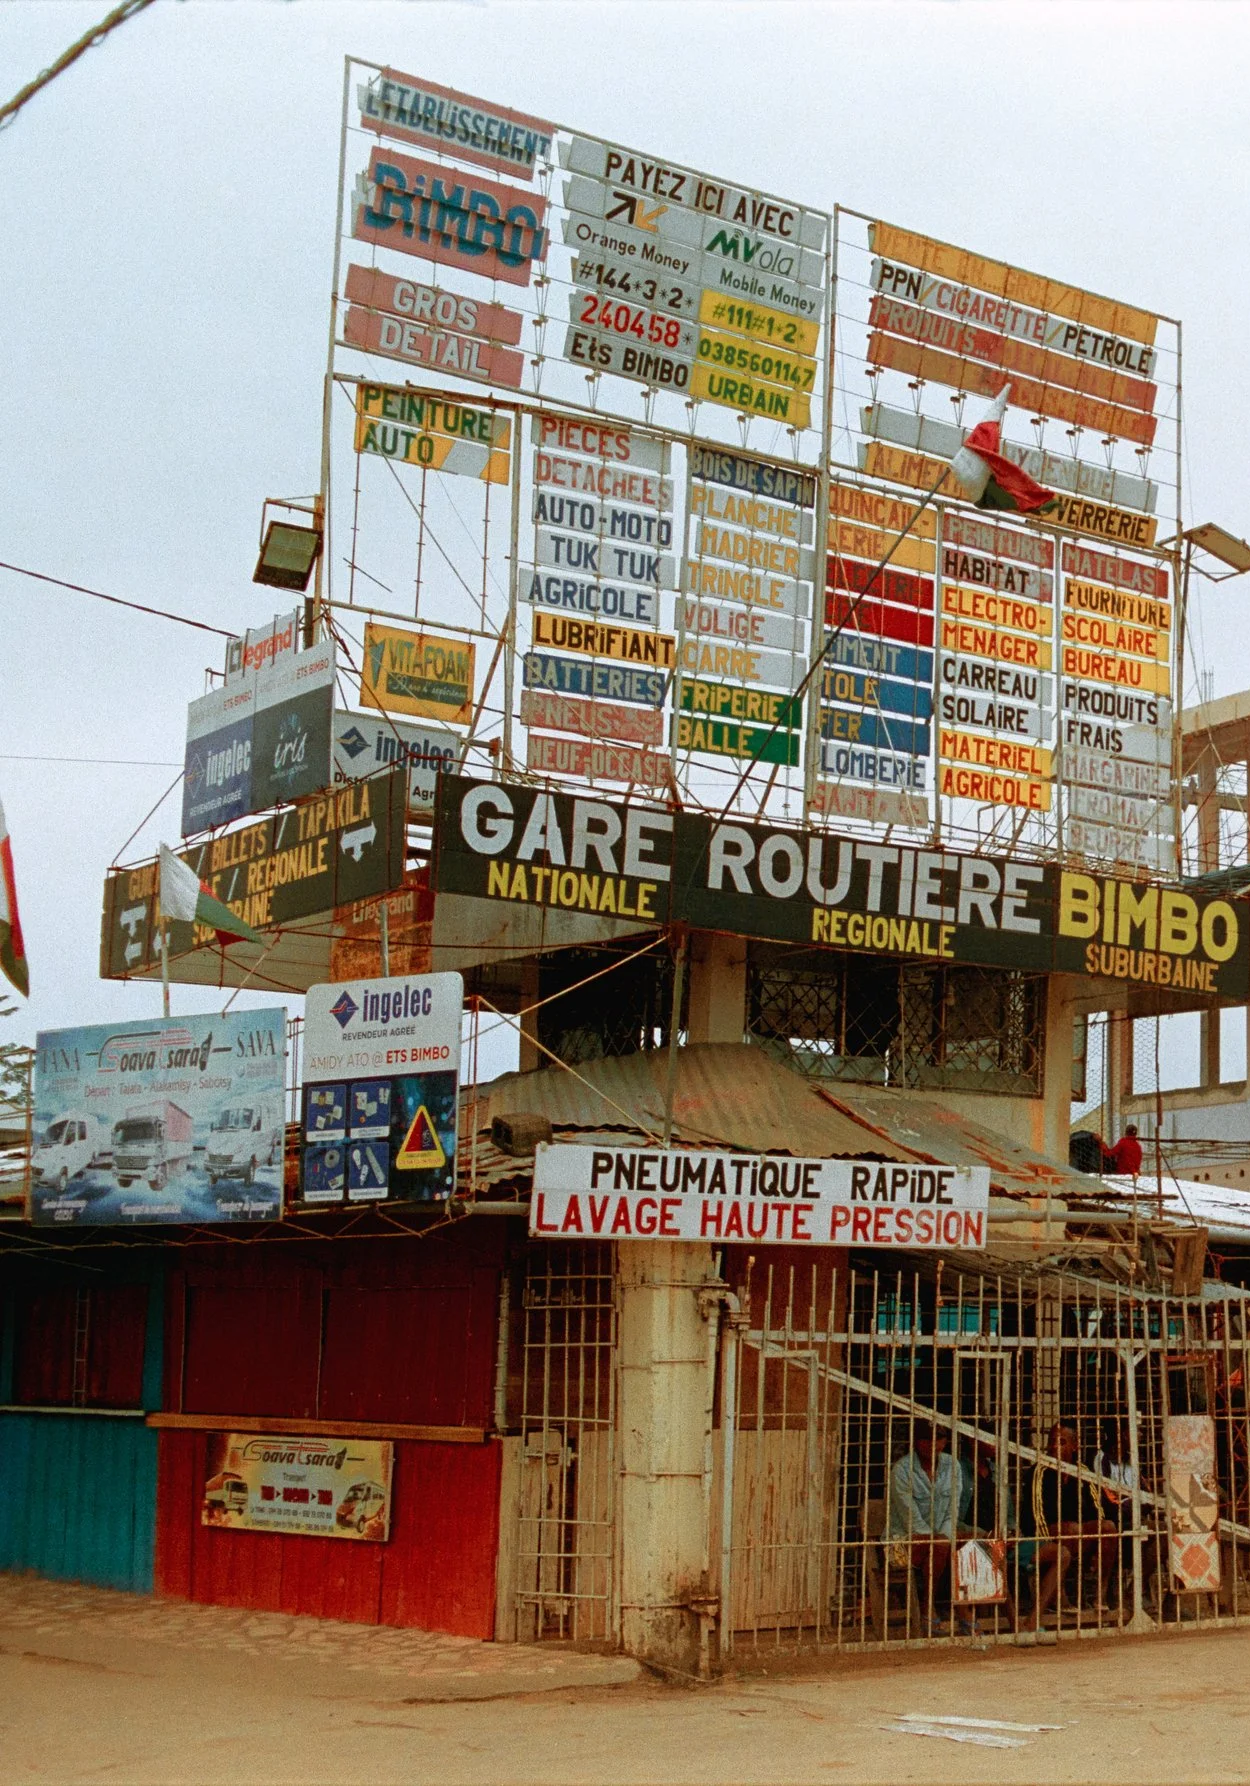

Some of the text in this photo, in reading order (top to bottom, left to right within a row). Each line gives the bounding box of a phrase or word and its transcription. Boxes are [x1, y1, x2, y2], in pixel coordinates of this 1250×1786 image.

[606, 152, 794, 236] PAYEZ ICI AVEC
[576, 223, 689, 275] Orange Money
[393, 282, 478, 330] GROS
[720, 268, 815, 315] Mobile Money
[622, 347, 688, 388] BIMBO
[708, 373, 790, 418] URBAIN
[363, 425, 434, 463] AUTO
[537, 454, 671, 504] DETACHEES
[735, 461, 759, 490] DE
[692, 486, 797, 537] PLANCHE
[550, 536, 662, 583] TUK TUK
[949, 517, 1048, 563] PEINTURE
[1064, 545, 1155, 591] MATELAS
[682, 641, 760, 679] CARRE
[942, 622, 1038, 666] MENAGER
[943, 658, 1037, 701] CARREAU
[1064, 649, 1141, 686] BUREAU
[523, 692, 612, 734] PNEUS
[819, 710, 860, 741] FER
[376, 730, 455, 774] ingelec
[678, 719, 753, 757] BALLE
[206, 740, 250, 787] ingelec
[212, 784, 370, 871] BILLETS TAPAKILA
[248, 837, 328, 894] REGIONALE
[461, 784, 1239, 963] GARE ROUTIERE BIMBO
[488, 860, 658, 919] NATIONALE
[812, 908, 956, 959] REGIONALE
[1086, 943, 1219, 993] SUBURBAINE
[363, 985, 432, 1024] ingelec
[236, 1030, 277, 1058] SAVA
[310, 1054, 344, 1070] AMIDY
[347, 1052, 370, 1065] ATO
[386, 1049, 408, 1065] ETS
[411, 1045, 450, 1062] BIMBO
[342, 1029, 387, 1041] REVENDEUR
[535, 1193, 984, 1247] LAVAGE HAUTE PRESSION
